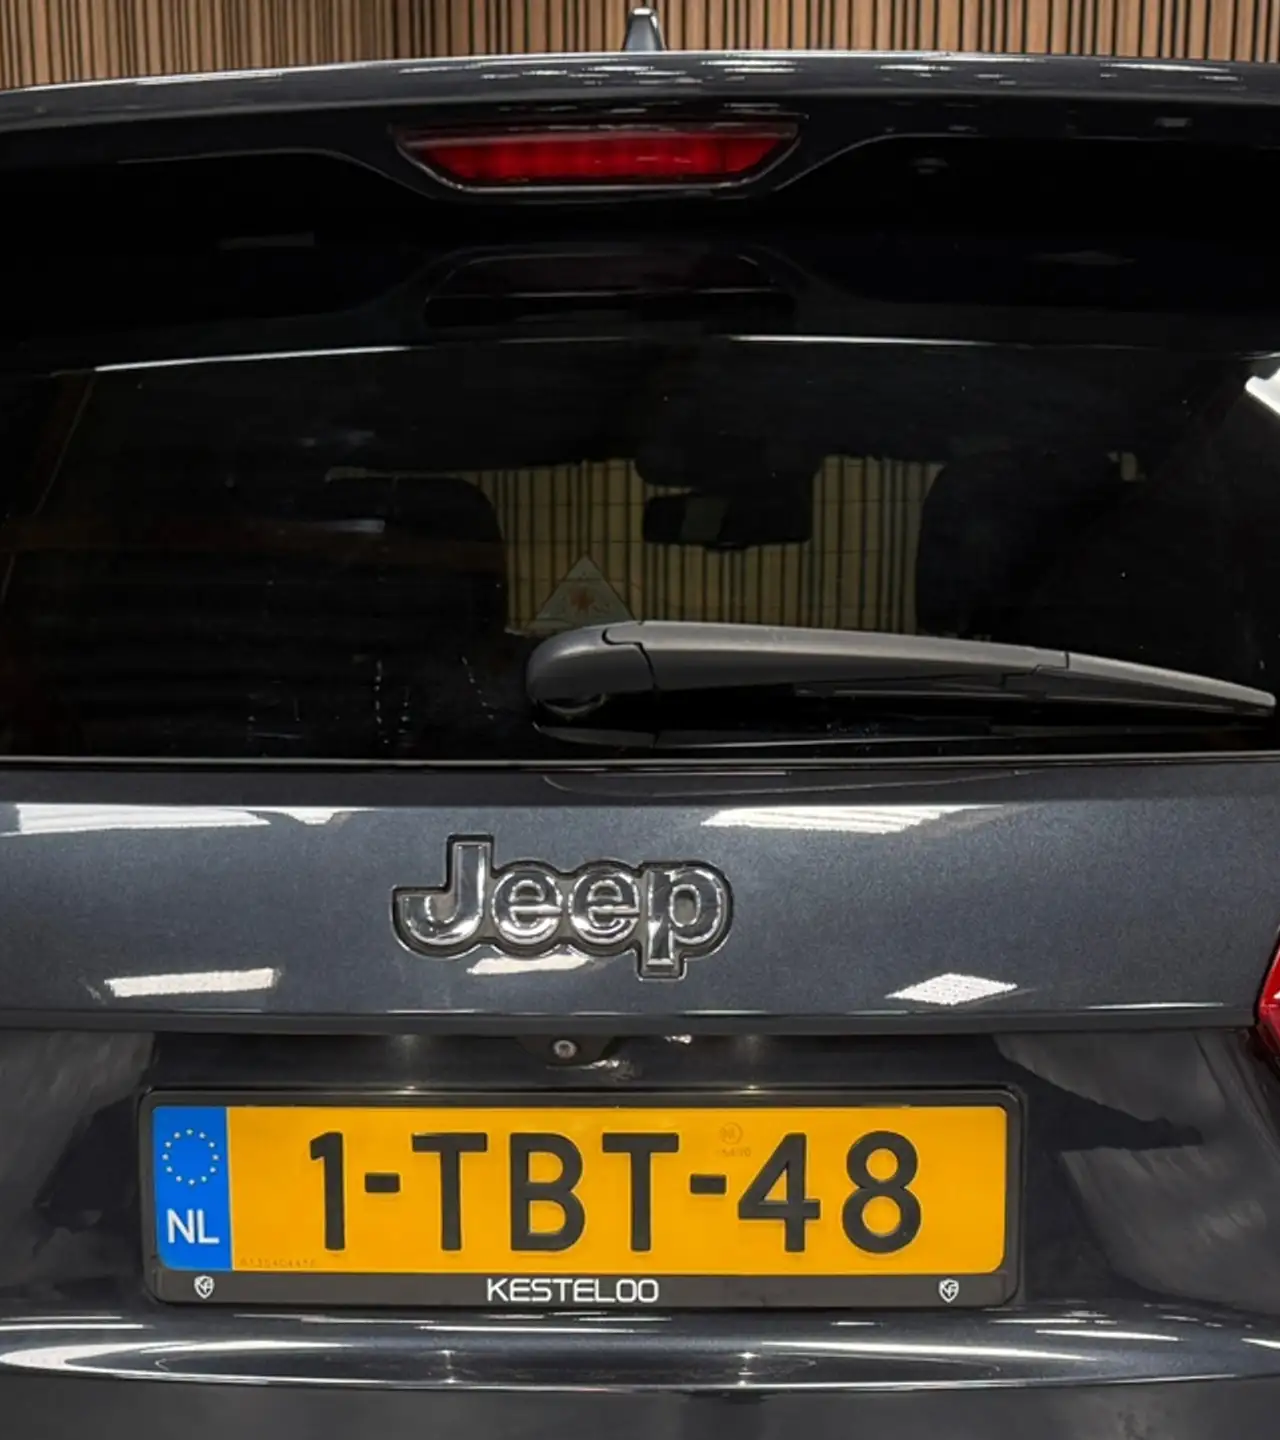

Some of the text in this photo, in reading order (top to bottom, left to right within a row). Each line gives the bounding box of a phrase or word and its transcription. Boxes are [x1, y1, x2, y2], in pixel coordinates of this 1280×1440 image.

[394, 836, 730, 976] Jeep
[166, 1208, 220, 1245] NL
[308, 1130, 922, 1254] 1-TBT-48
[486, 1277, 660, 1303] KESTELOO
